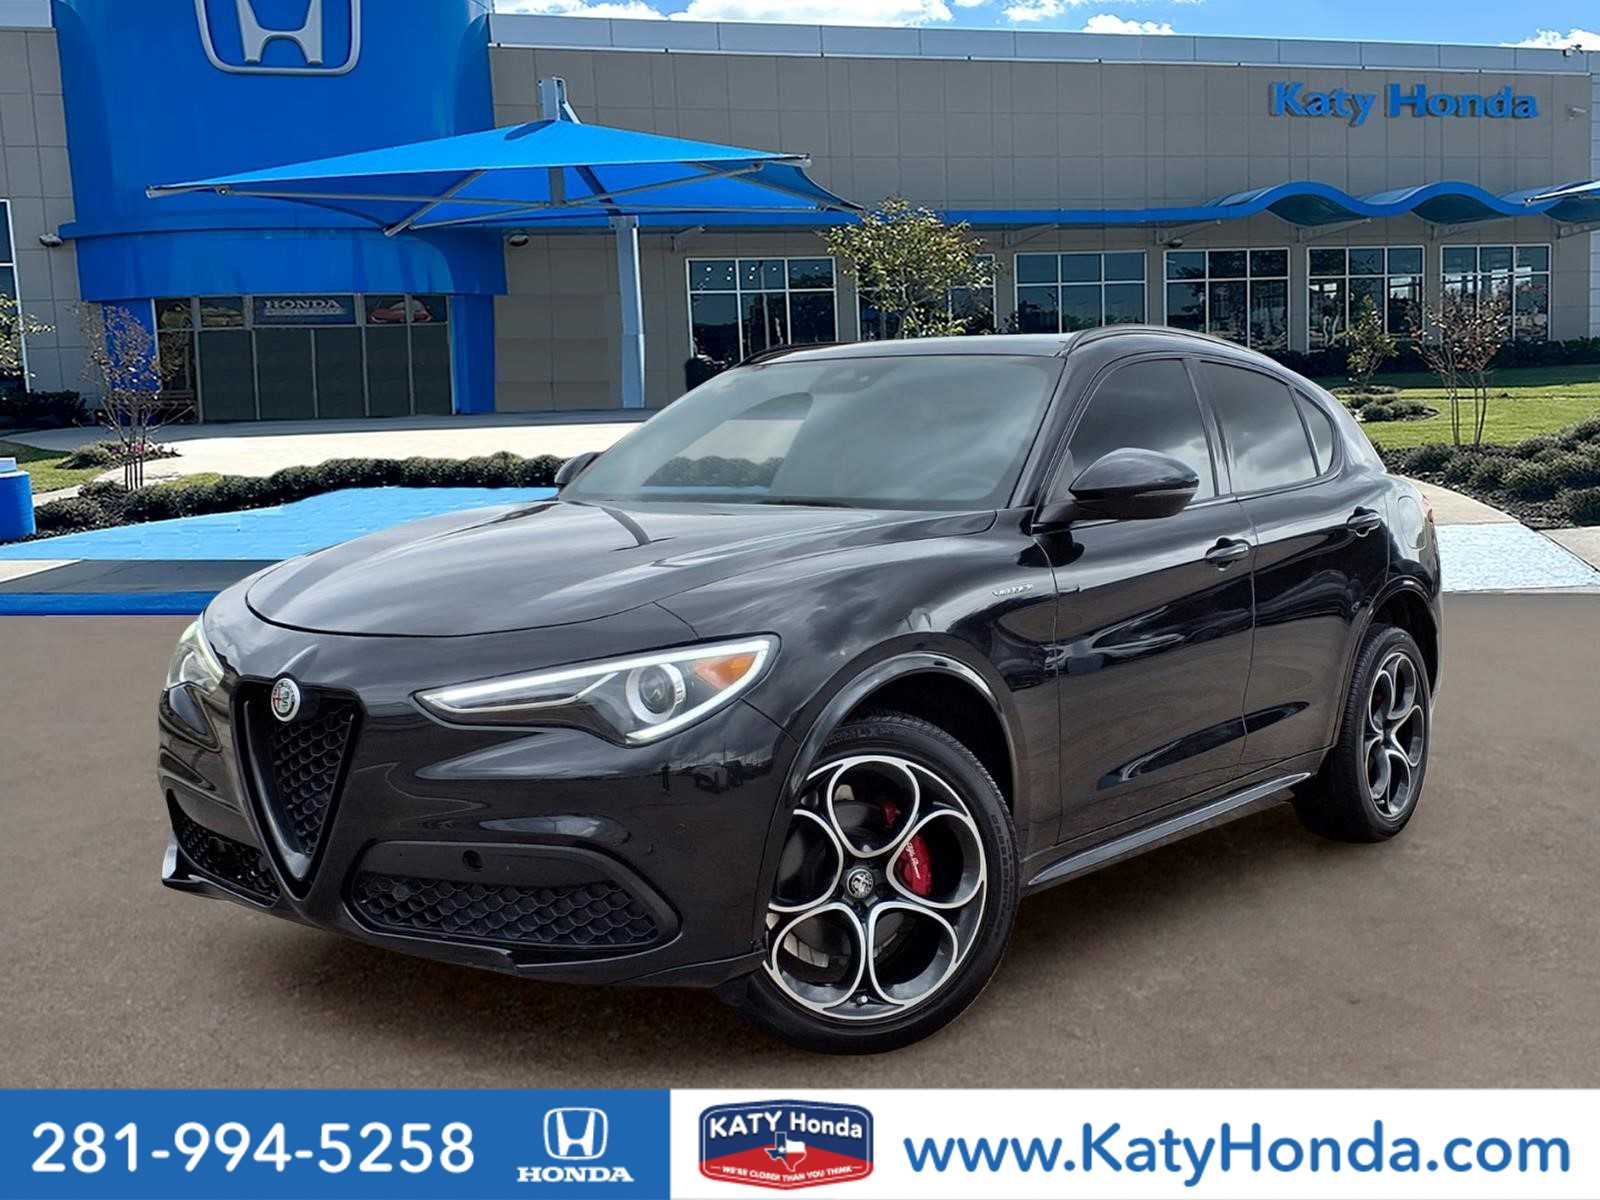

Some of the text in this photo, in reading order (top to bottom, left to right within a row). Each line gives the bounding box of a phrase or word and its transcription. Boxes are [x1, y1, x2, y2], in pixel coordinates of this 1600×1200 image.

[1269, 81, 1538, 127] Katy Honda
[264, 299, 342, 309] HONDA
